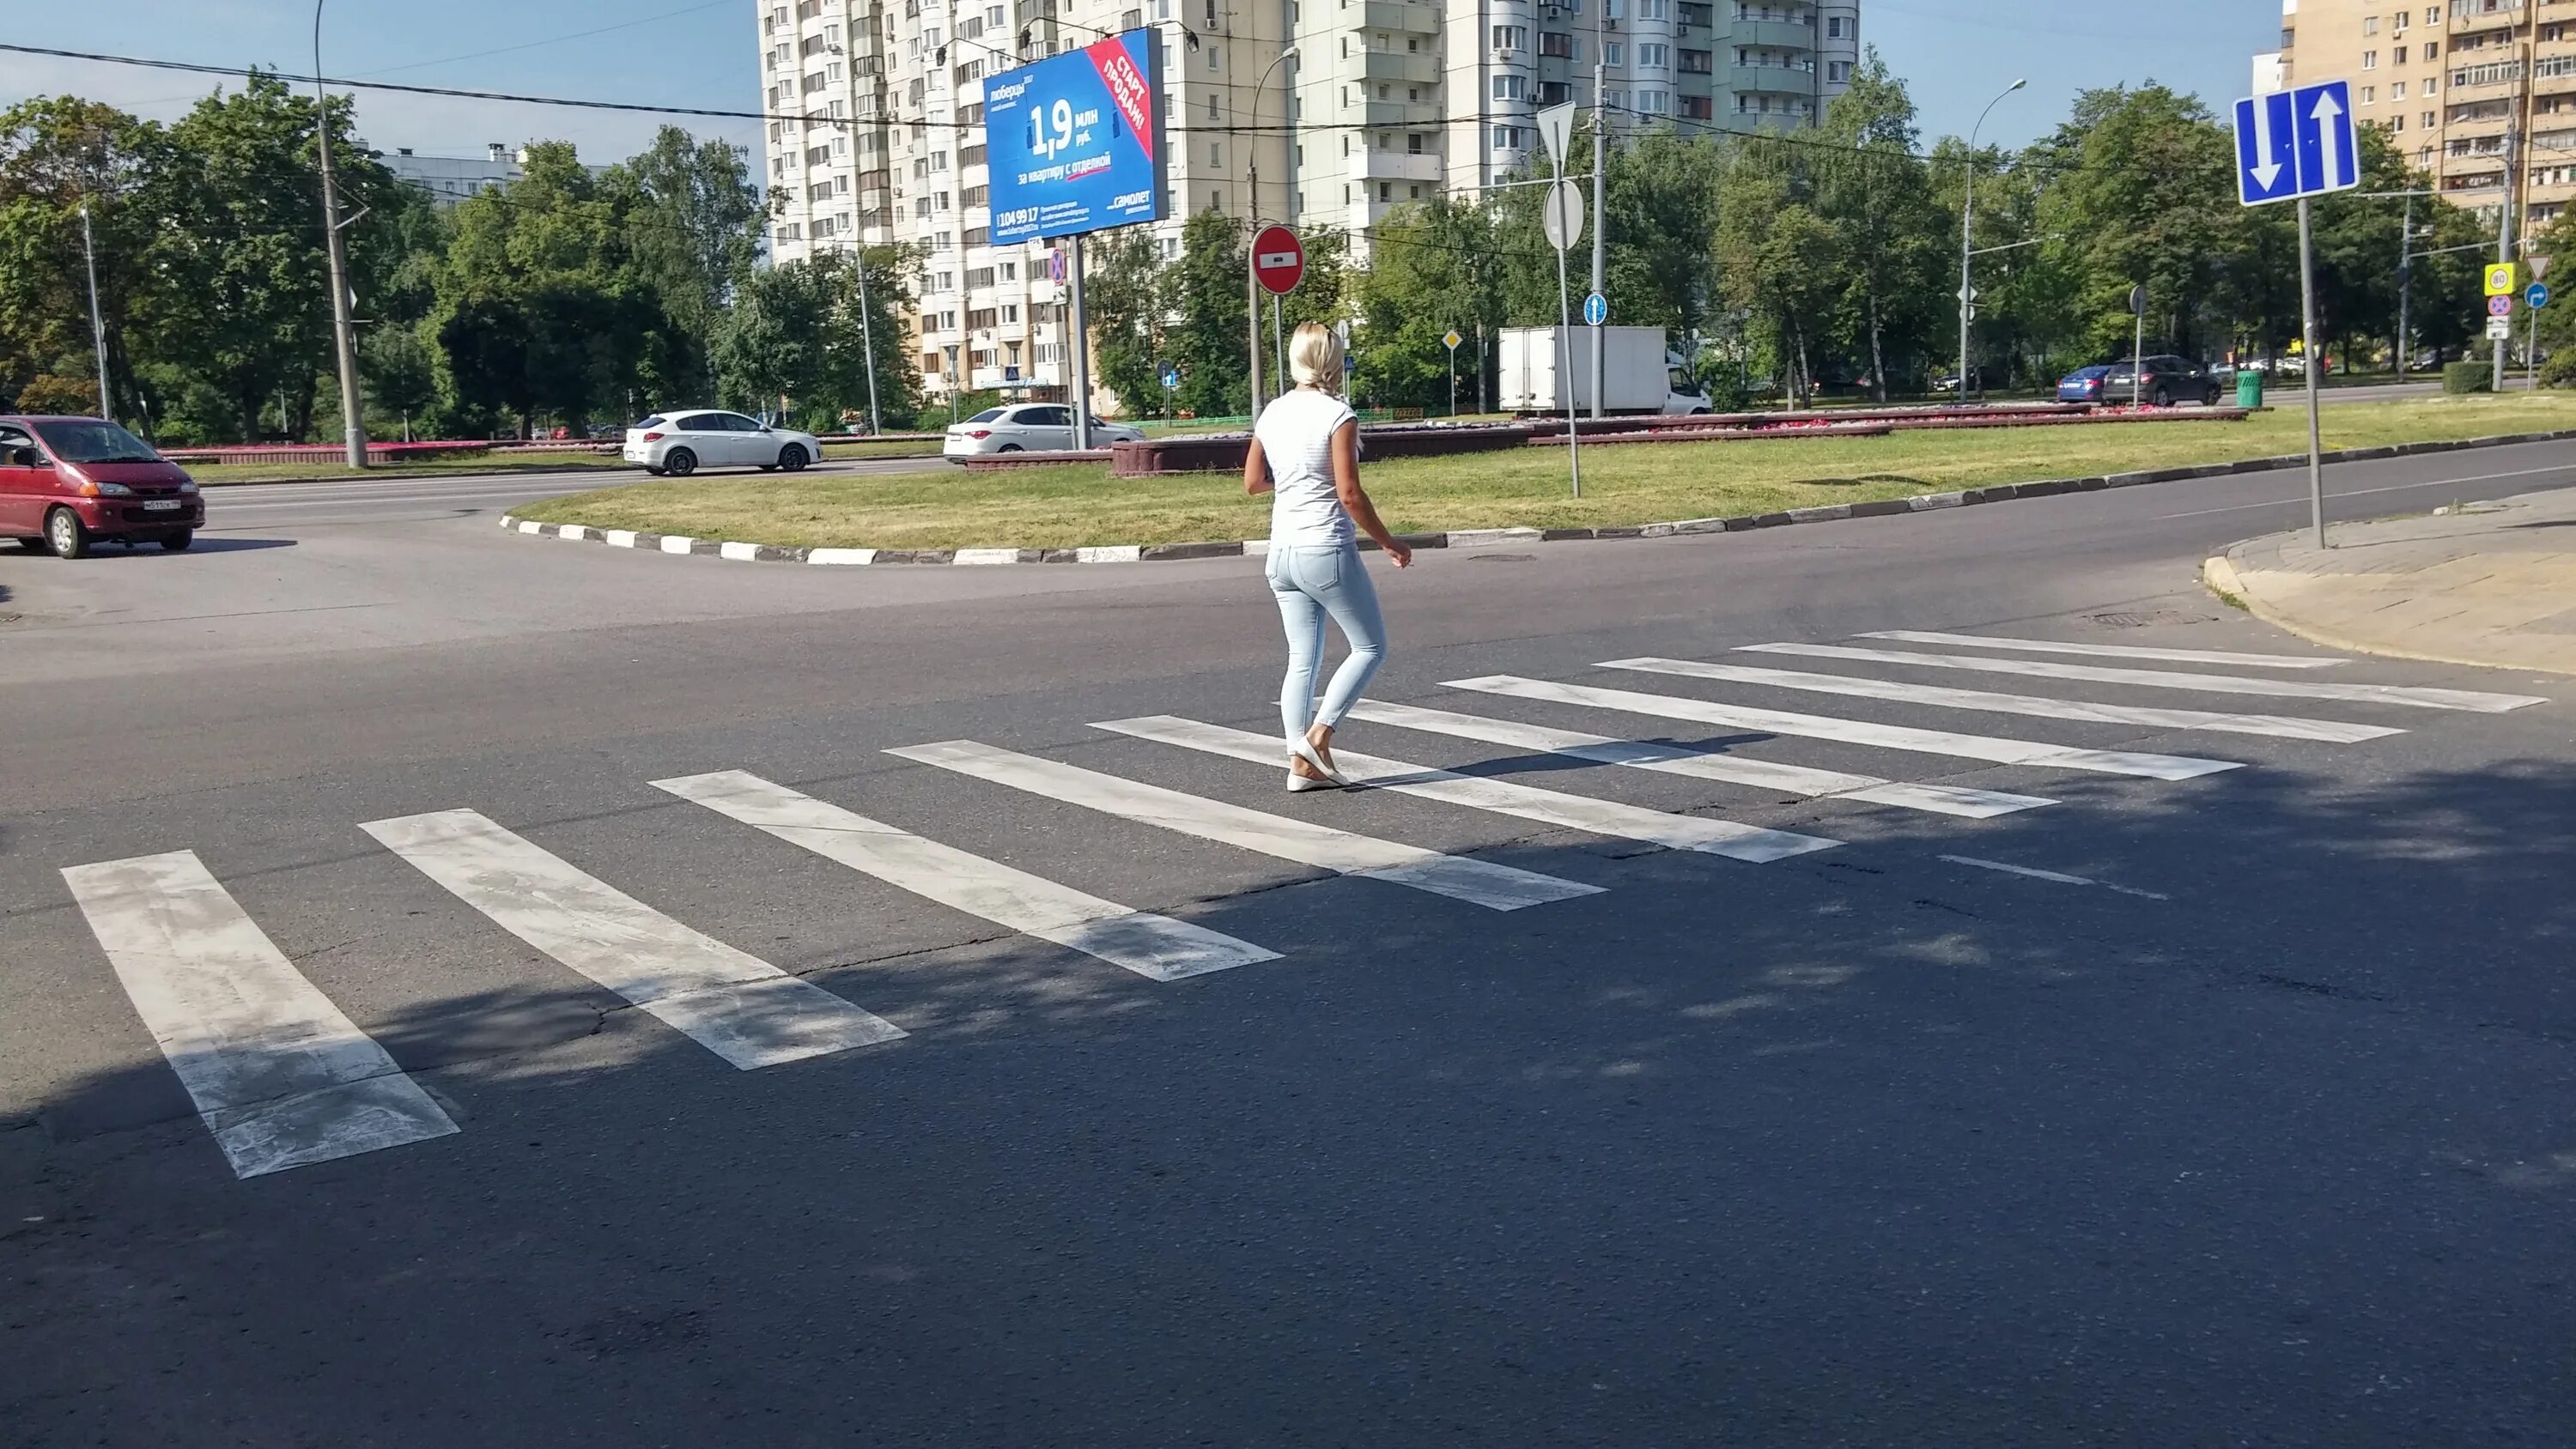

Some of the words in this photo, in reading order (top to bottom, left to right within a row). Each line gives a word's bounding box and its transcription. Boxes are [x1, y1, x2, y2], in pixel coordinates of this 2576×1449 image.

[1116, 56, 1145, 101] СТАРТ
[990, 83, 1025, 102] люберцы
[1103, 58, 1145, 131] ПРОДАЖ!
[1075, 108, 1099, 128] млн
[1030, 99, 1072, 161] 1,9
[1076, 130, 1092, 148] руб.
[1018, 174, 1027, 185] за
[1029, 165, 1064, 185] квартиру
[1066, 166, 1072, 175] с
[1072, 151, 1111, 173] отделкой
[999, 212, 1016, 227] 104
[1016, 209, 1027, 224] 99
[1028, 206, 1039, 222] 17
[2493, 275, 2505, 284] 80
